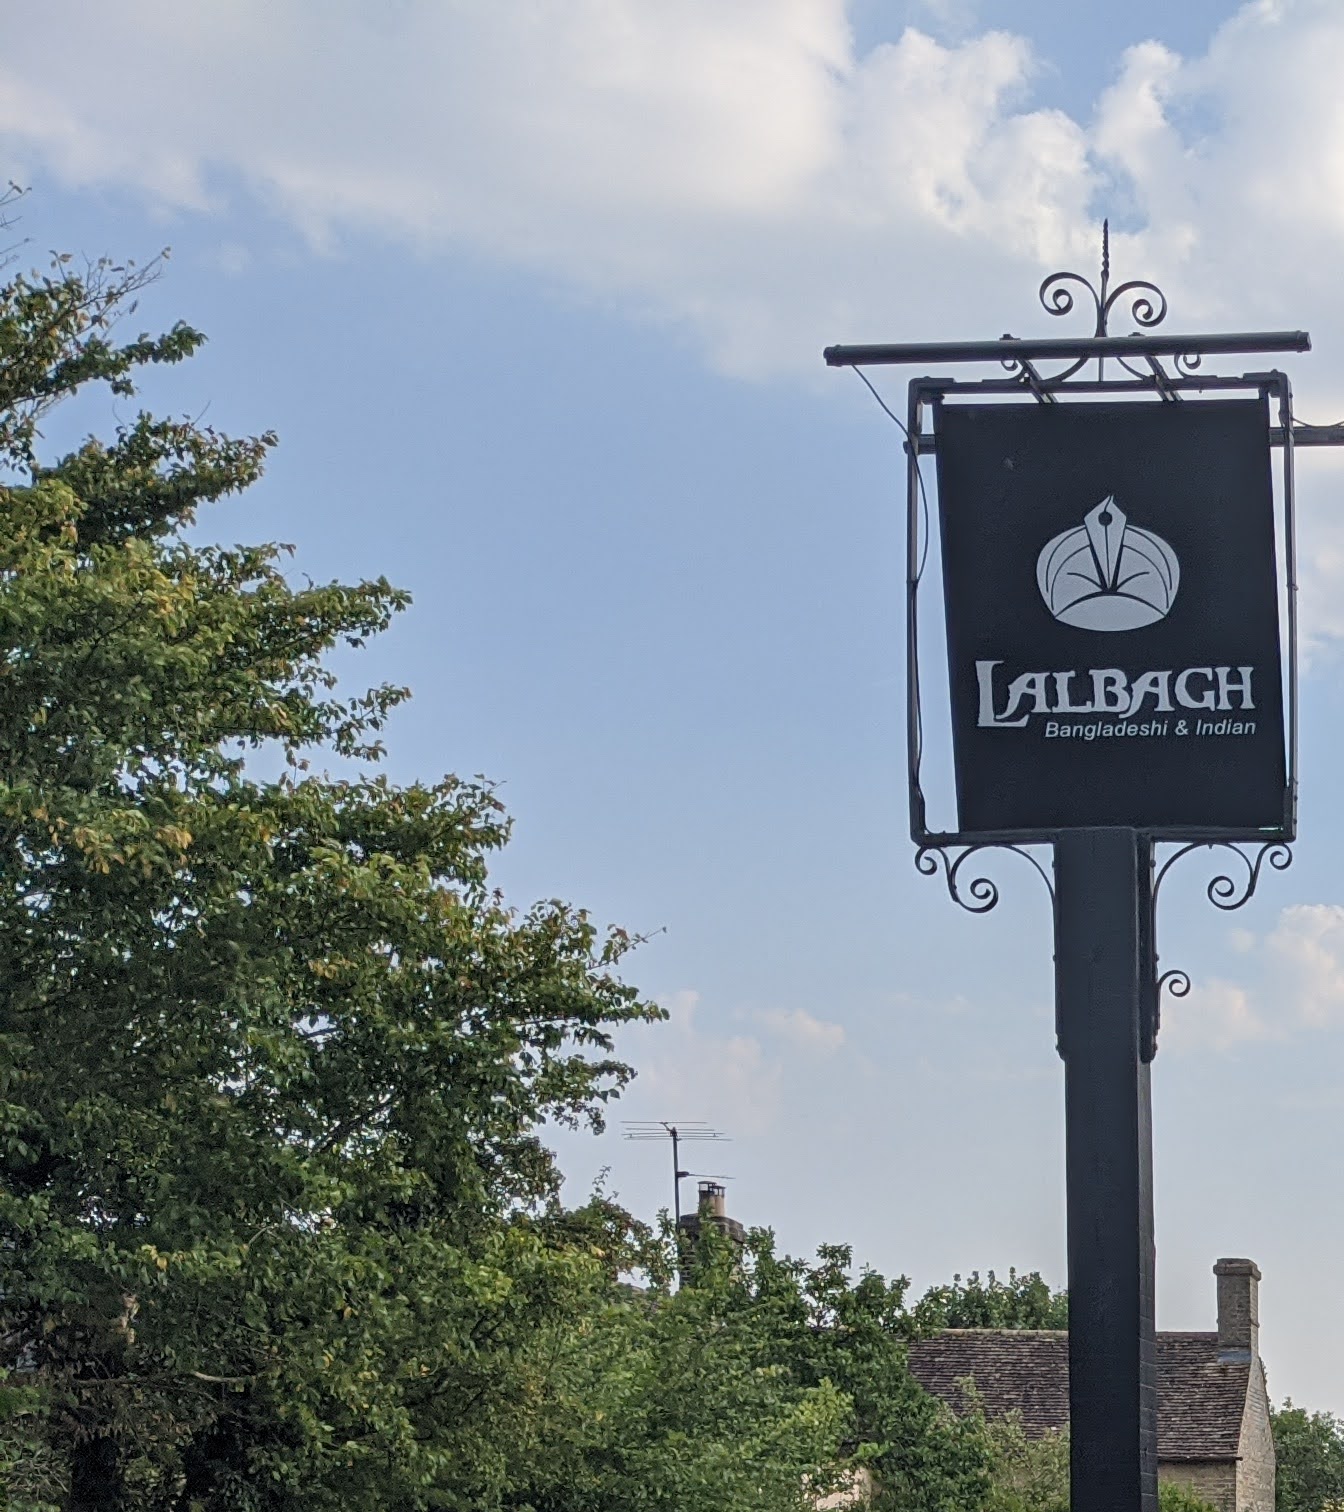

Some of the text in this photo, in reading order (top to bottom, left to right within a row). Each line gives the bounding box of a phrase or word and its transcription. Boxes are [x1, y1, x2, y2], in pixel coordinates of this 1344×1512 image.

[976, 660, 1255, 727] LALBAGH
[1045, 720, 1256, 740] Bangladeshi & Indian
